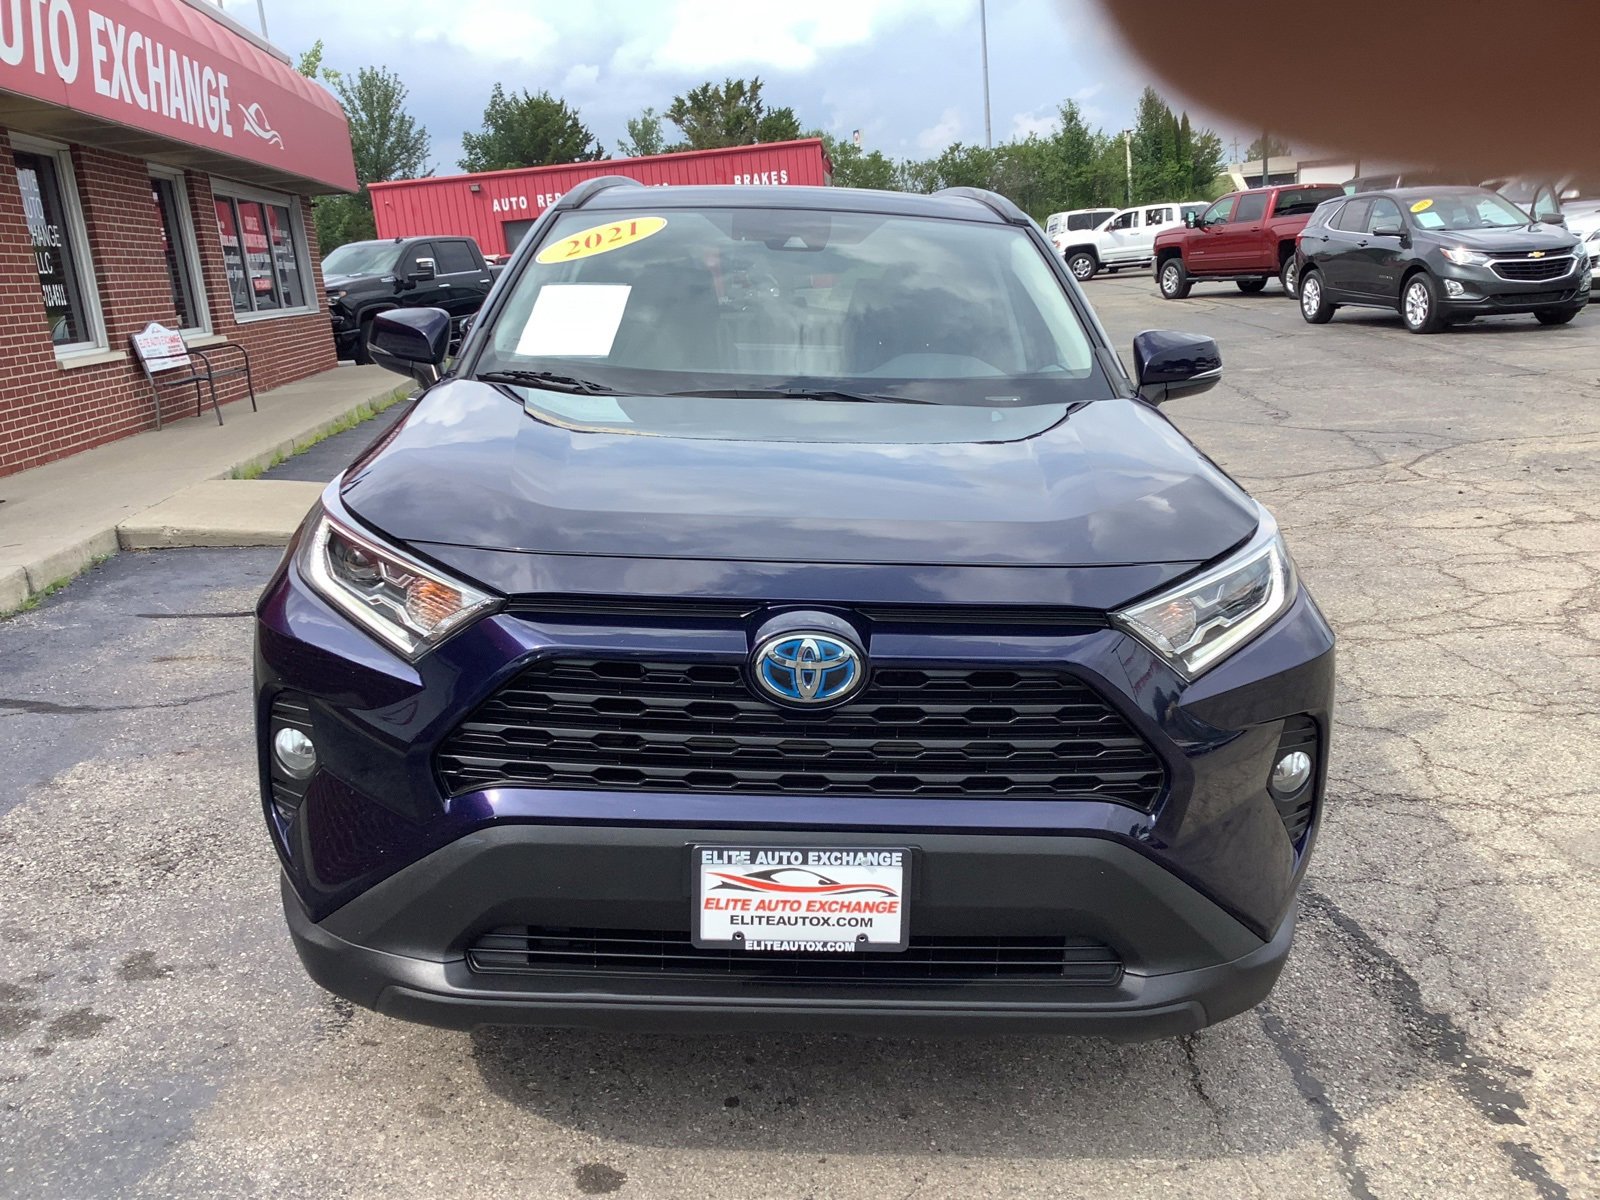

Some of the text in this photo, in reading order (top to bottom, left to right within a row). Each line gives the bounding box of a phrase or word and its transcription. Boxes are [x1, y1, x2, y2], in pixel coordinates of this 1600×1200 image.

[88, 9, 234, 138] EXCHANGE
[734, 170, 788, 185] BRAKES
[493, 196, 527, 212] AUTO
[565, 221, 637, 257] 2021
[35, 252, 53, 274] LLC
[702, 851, 903, 866] ELITE AUTO EXCHANGE
[704, 897, 899, 914] ELITE AUTO EXCHANGE
[730, 915, 873, 928] ELITEAUTOX.COM
[745, 940, 856, 952] ELITEAUTOX.COM
